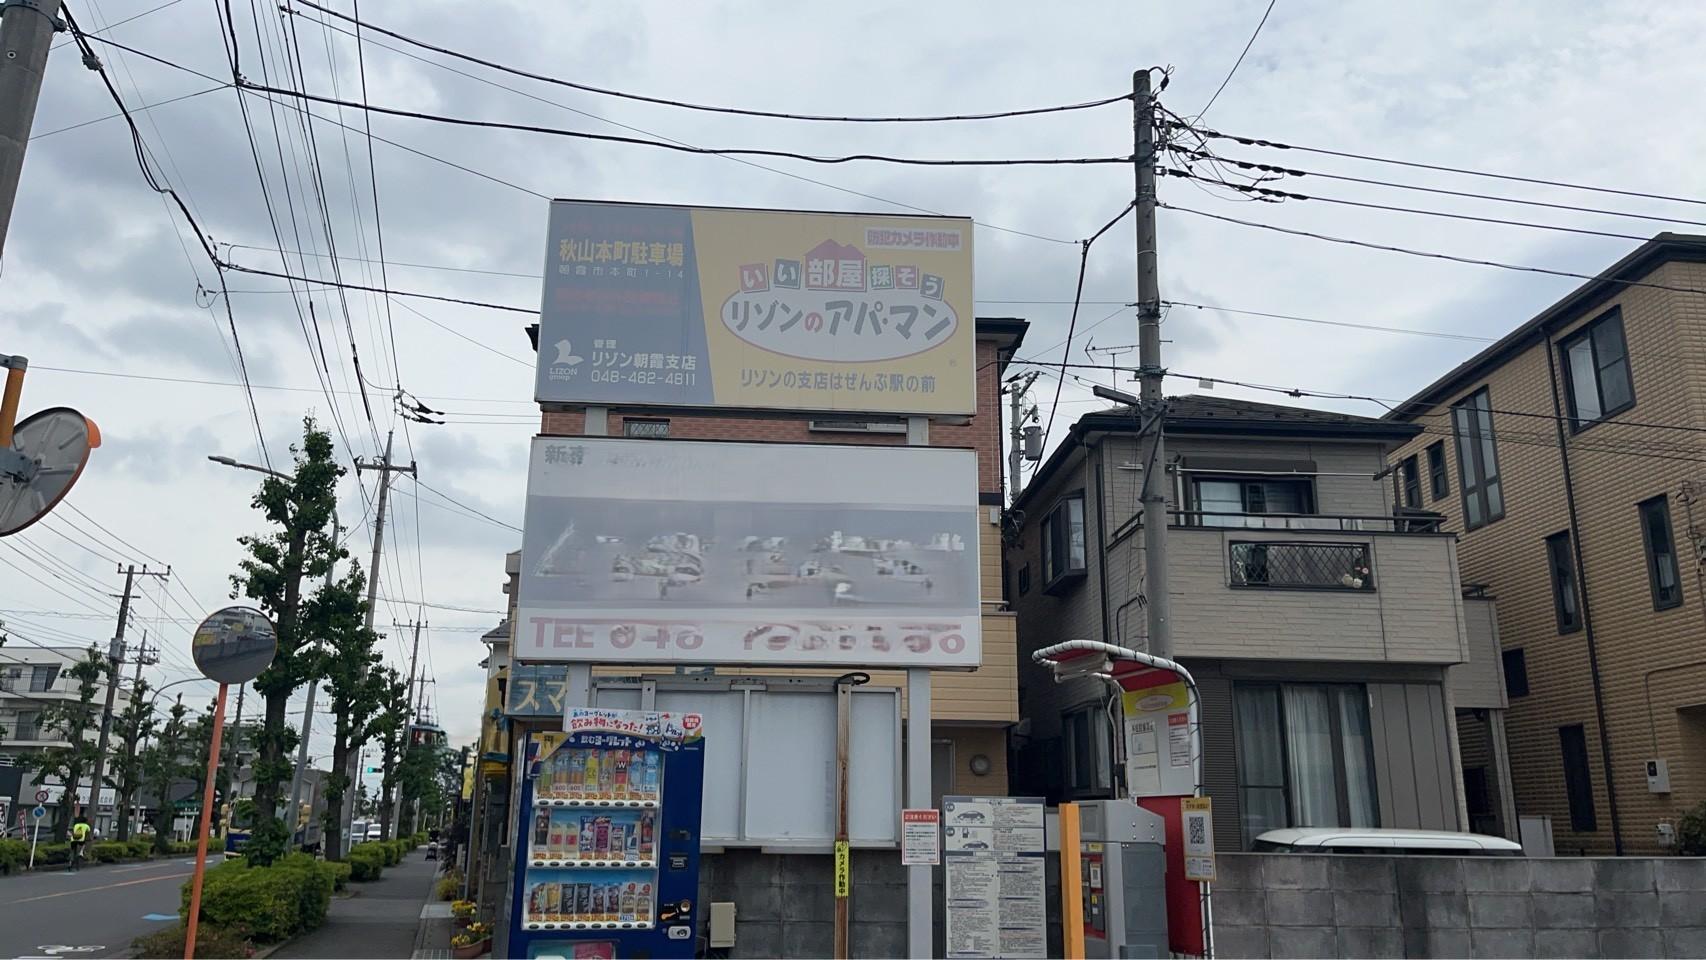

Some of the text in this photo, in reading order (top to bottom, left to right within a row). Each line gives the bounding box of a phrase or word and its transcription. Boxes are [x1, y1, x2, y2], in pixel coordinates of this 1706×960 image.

[559, 238, 684, 267] 秋山本町駐車場
[741, 258, 941, 296] いい部屋探そう
[549, 367, 578, 376] LIZON
[592, 351, 697, 371] リゾン朝霞支店
[741, 368, 936, 393] リゾンの支店はぜんぶ駅の前
